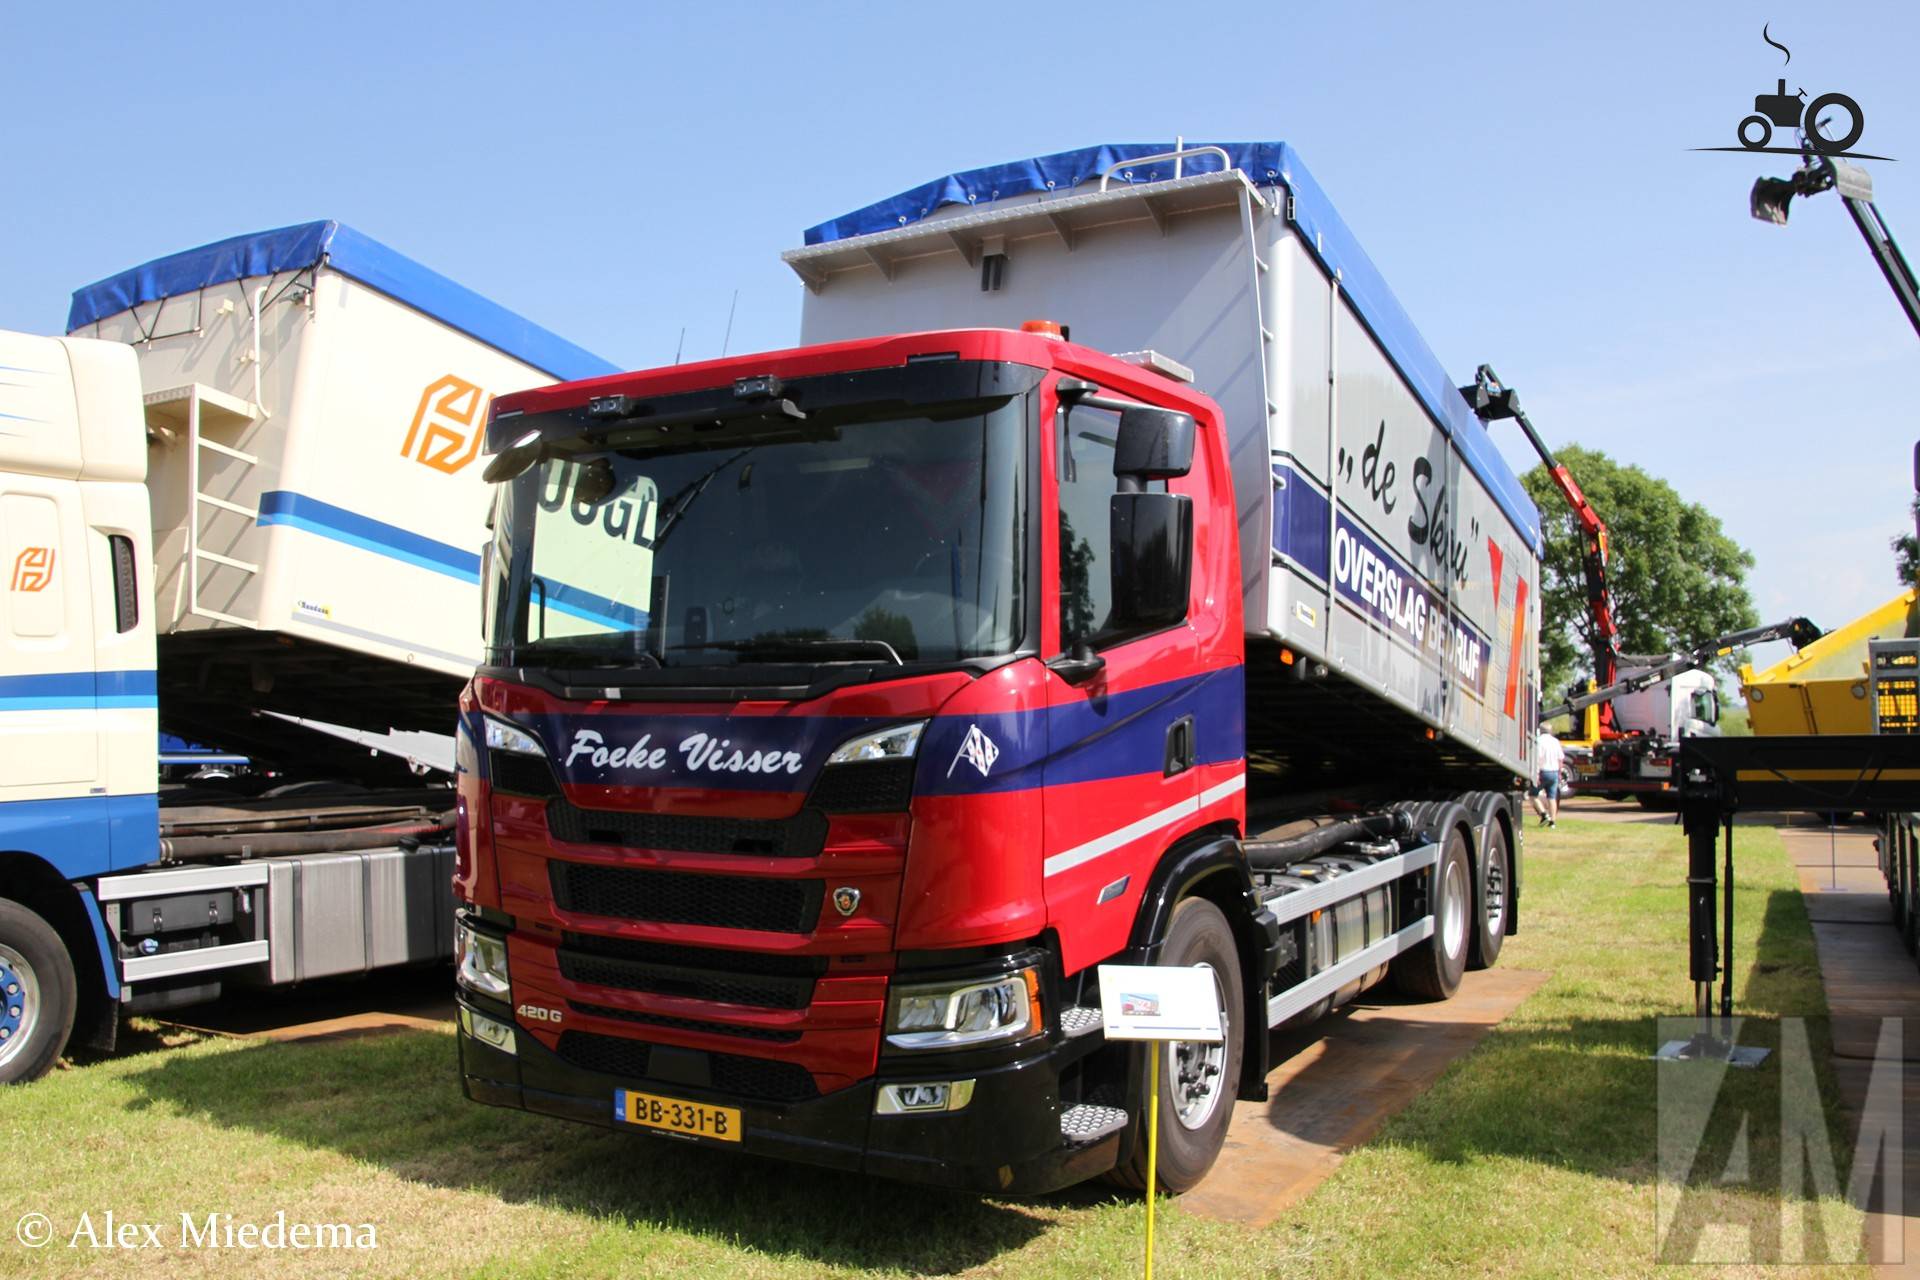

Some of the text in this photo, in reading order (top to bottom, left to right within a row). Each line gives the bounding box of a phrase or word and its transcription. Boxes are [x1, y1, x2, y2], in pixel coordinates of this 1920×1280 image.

[565, 729, 803, 774] Foeke Visser
[636, 1096, 728, 1135] BB-331-B
